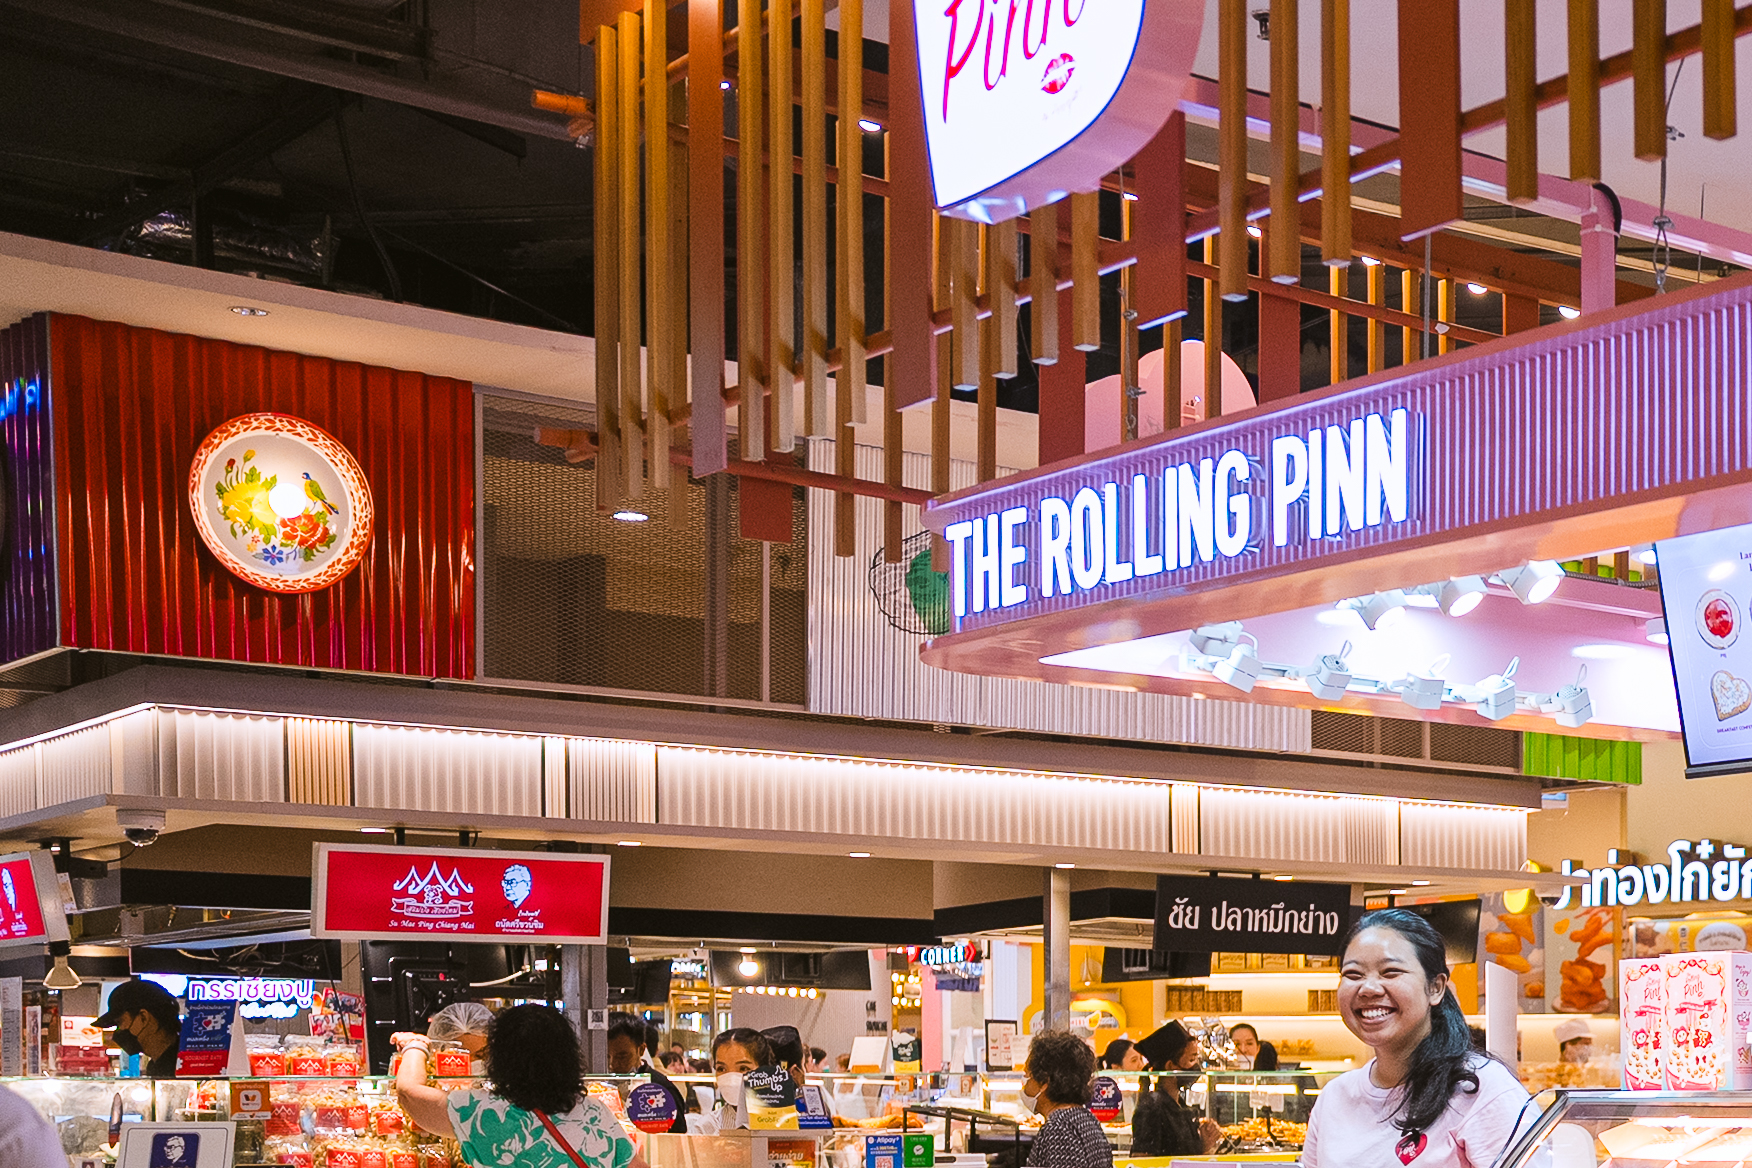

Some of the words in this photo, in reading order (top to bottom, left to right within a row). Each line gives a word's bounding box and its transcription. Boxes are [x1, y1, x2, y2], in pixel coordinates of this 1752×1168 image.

[945, 506, 1027, 618] THE
[1040, 449, 1250, 598] ROLLING
[1271, 408, 1408, 547] PINN
[418, 920, 434, 930] Ping
[435, 921, 459, 930] Chiang
[460, 921, 475, 929] Mai
[1211, 900, 1339, 935] ปลาหมึกย่าง
[920, 945, 965, 966] CORNER
[748, 1074, 784, 1088] Thumbs
